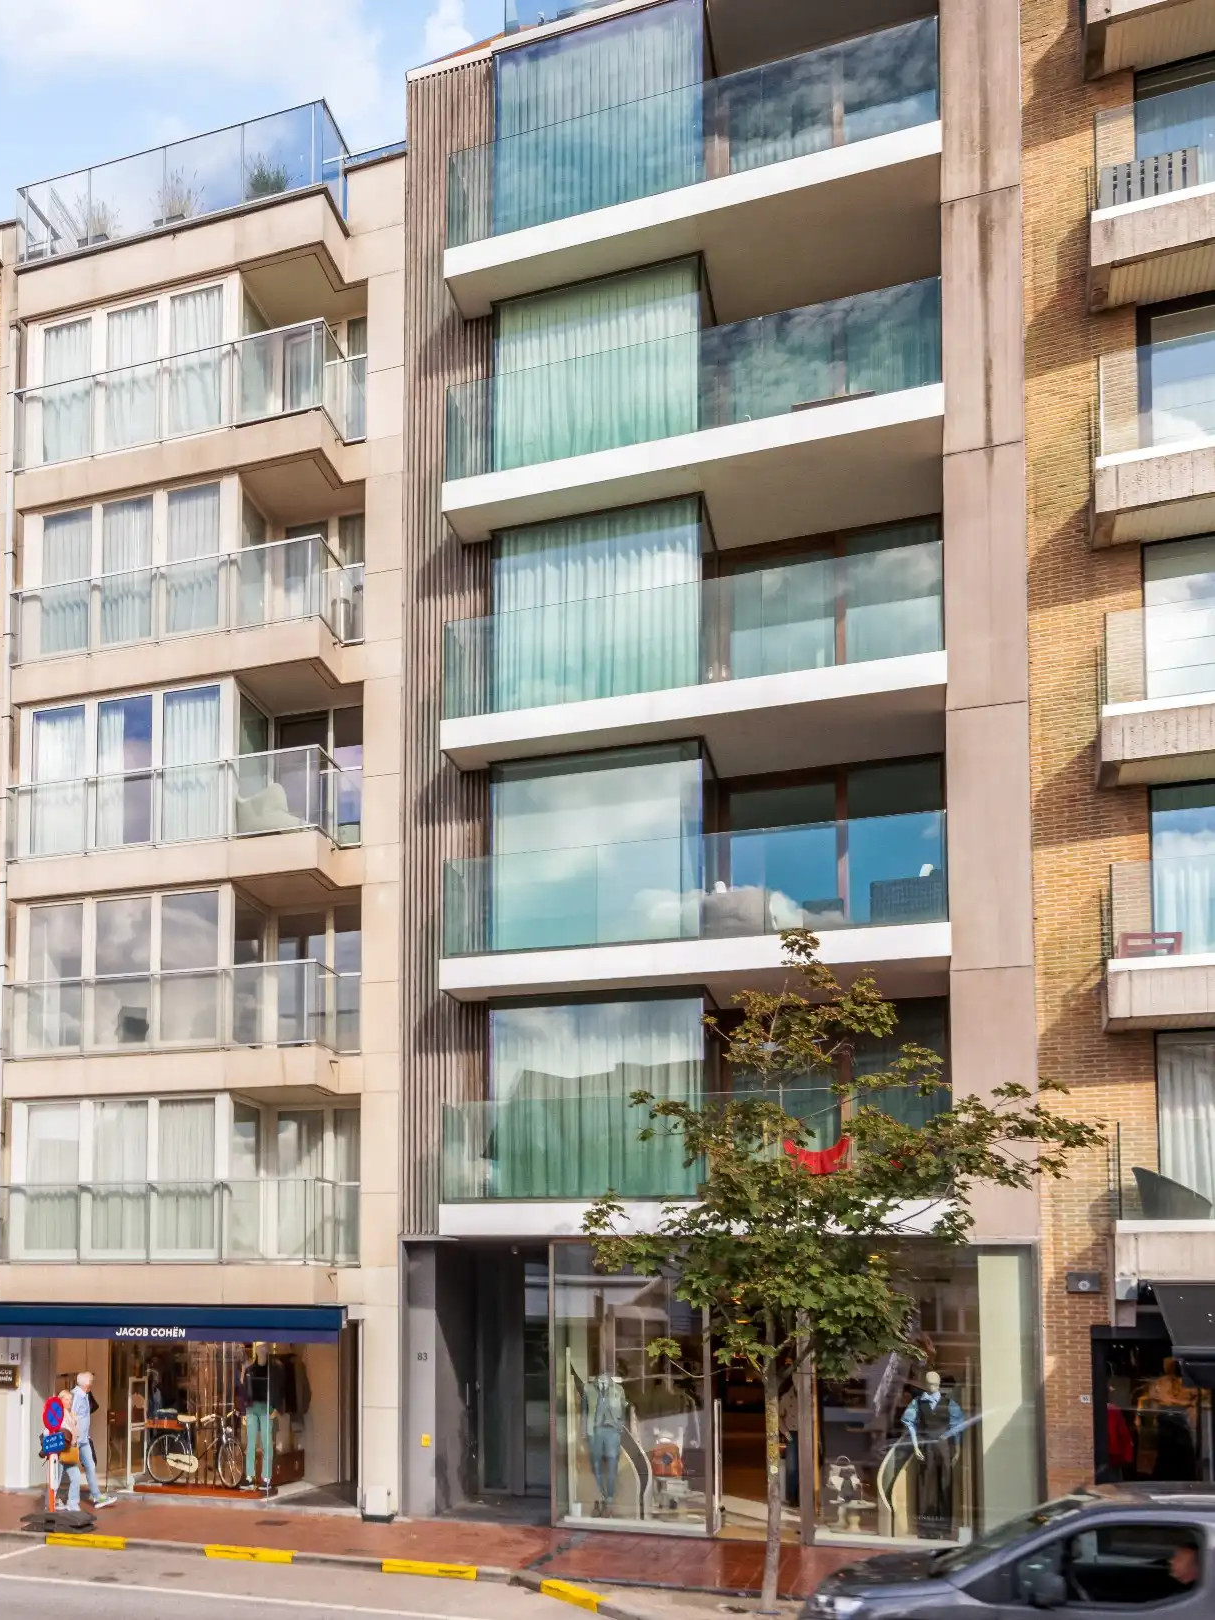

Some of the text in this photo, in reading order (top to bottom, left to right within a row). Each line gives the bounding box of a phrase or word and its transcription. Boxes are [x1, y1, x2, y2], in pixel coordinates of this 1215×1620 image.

[115, 1326, 186, 1338] JACOB COHËN
[10, 1352, 20, 1361] 81
[416, 1351, 428, 1361] 83
